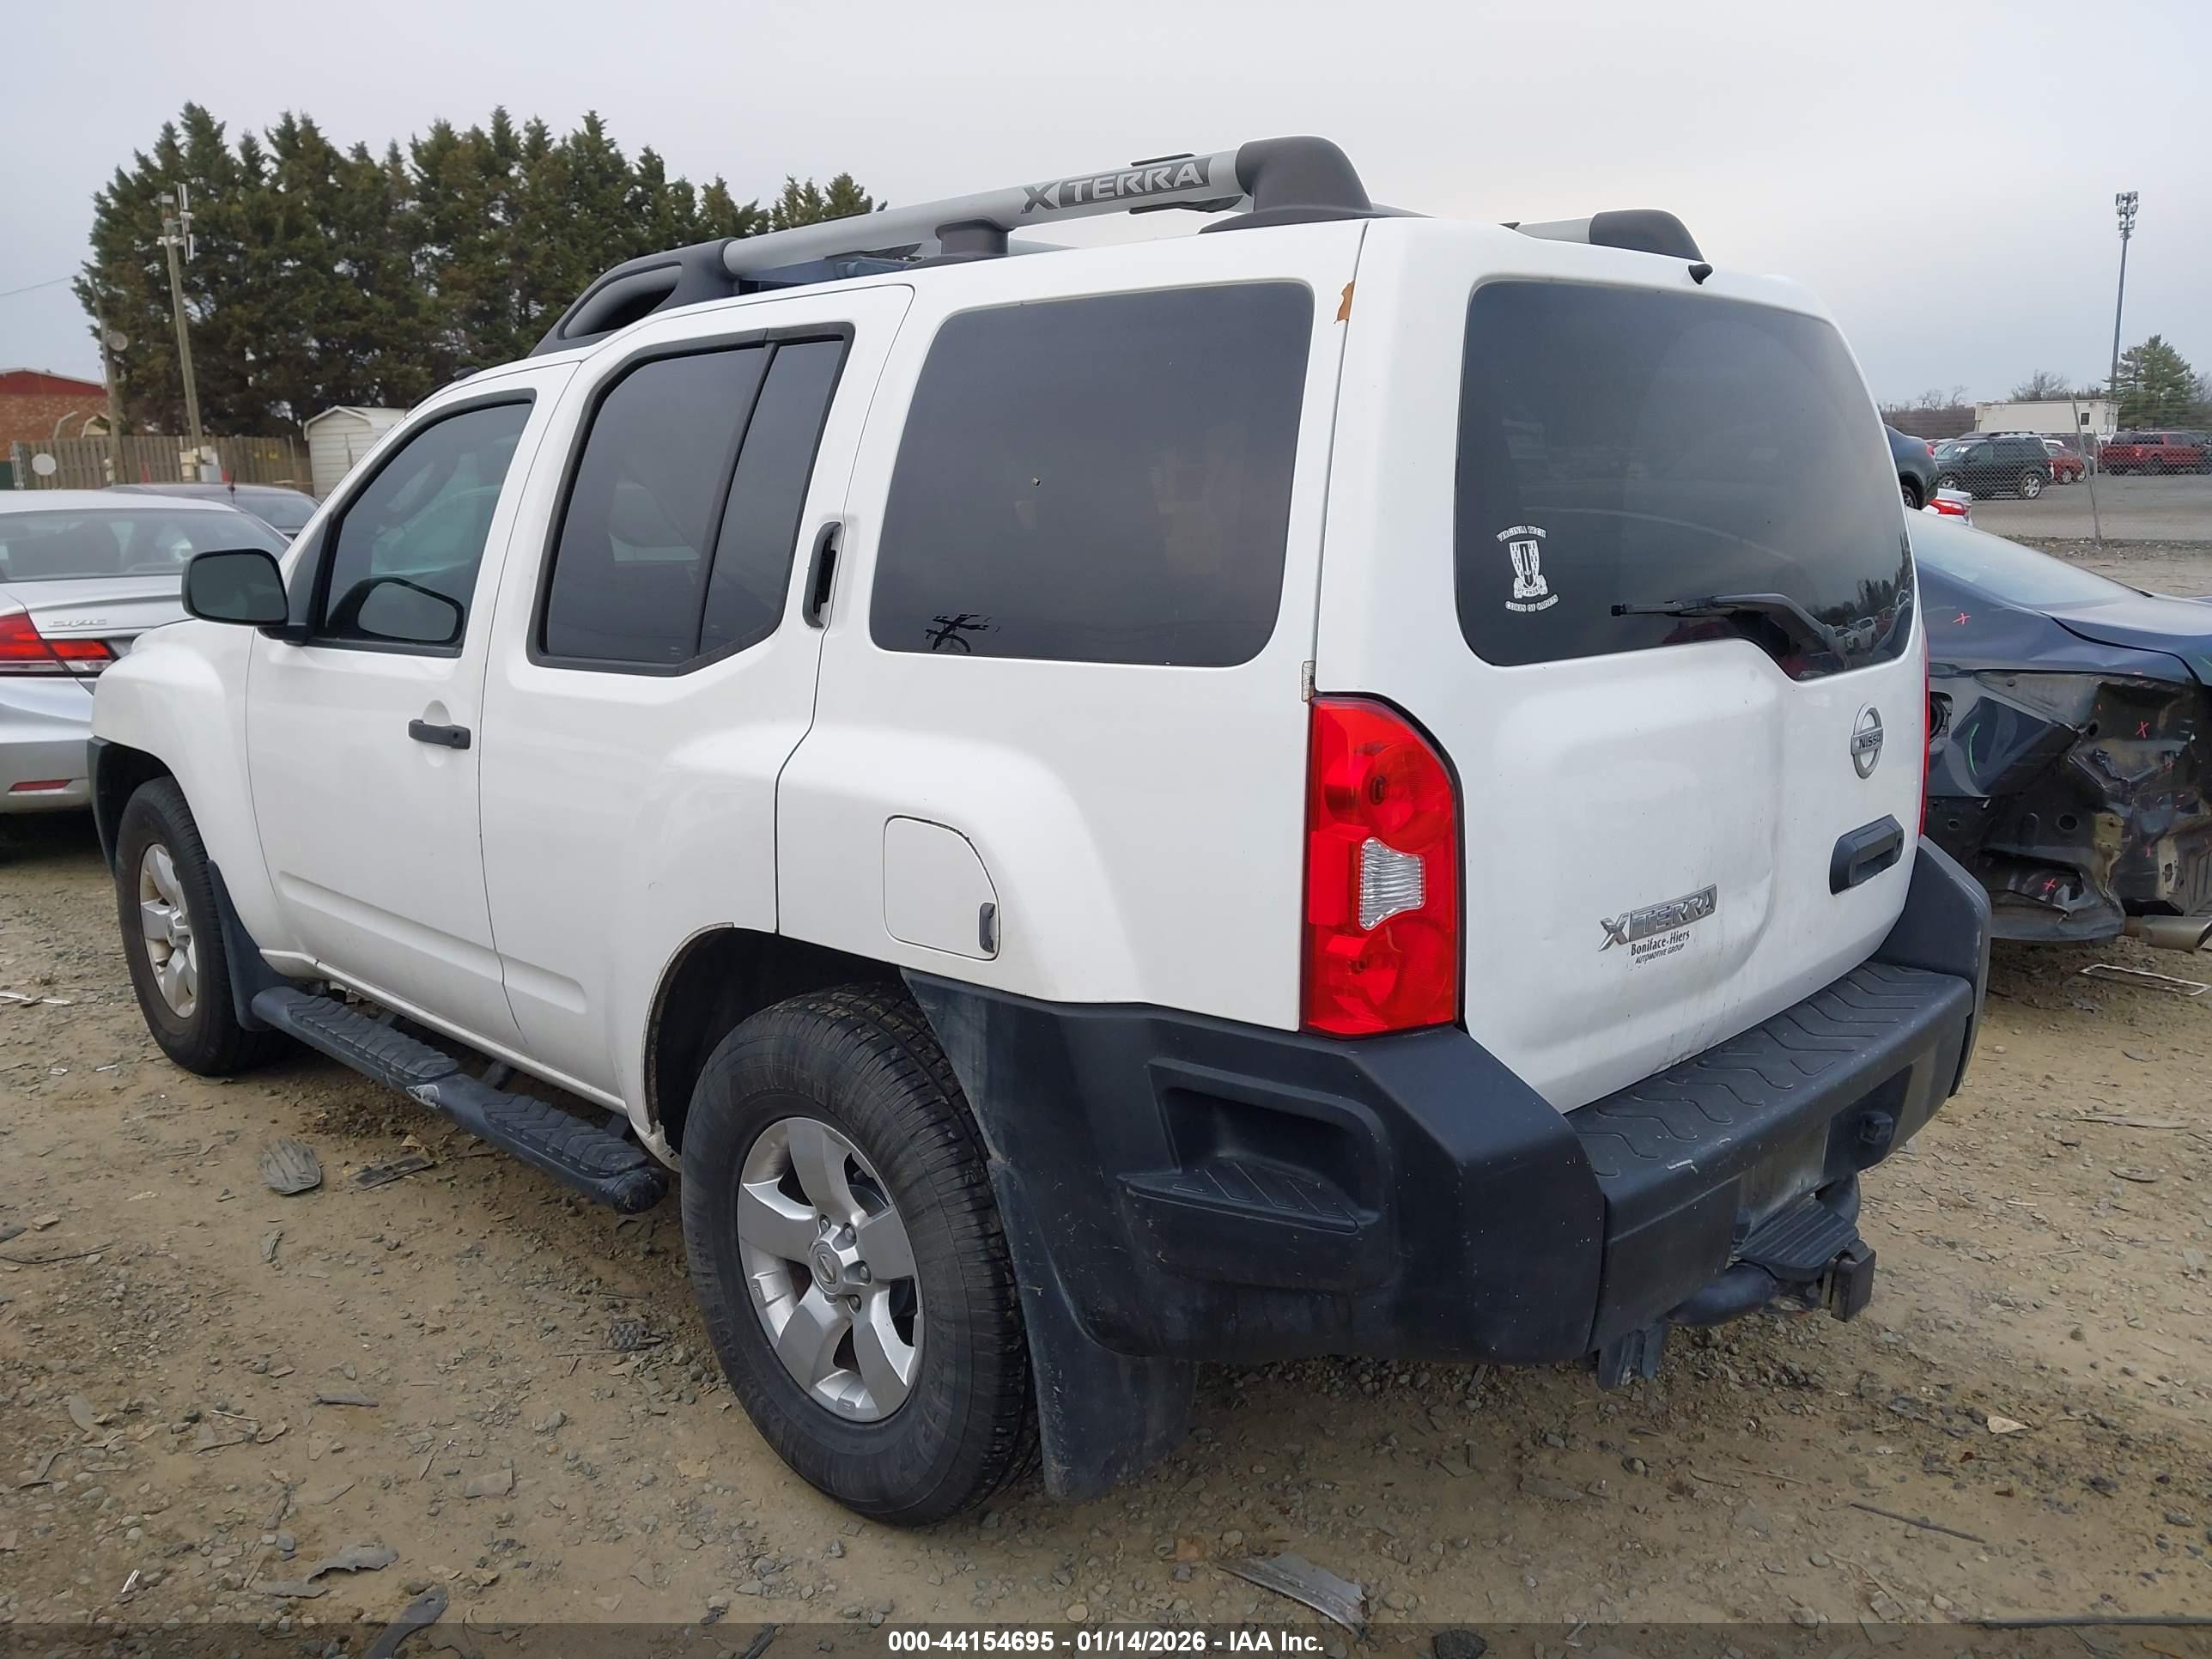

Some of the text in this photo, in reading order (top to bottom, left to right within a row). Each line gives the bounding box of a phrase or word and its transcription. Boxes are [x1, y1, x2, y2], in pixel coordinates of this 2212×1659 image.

[1020, 162, 1204, 215] XTERRA
[1497, 526, 1528, 543] VIRGINIA
[1598, 891, 1716, 952] XTERRA
[1635, 943, 1685, 964] AUTOMOTIVE GROUP
